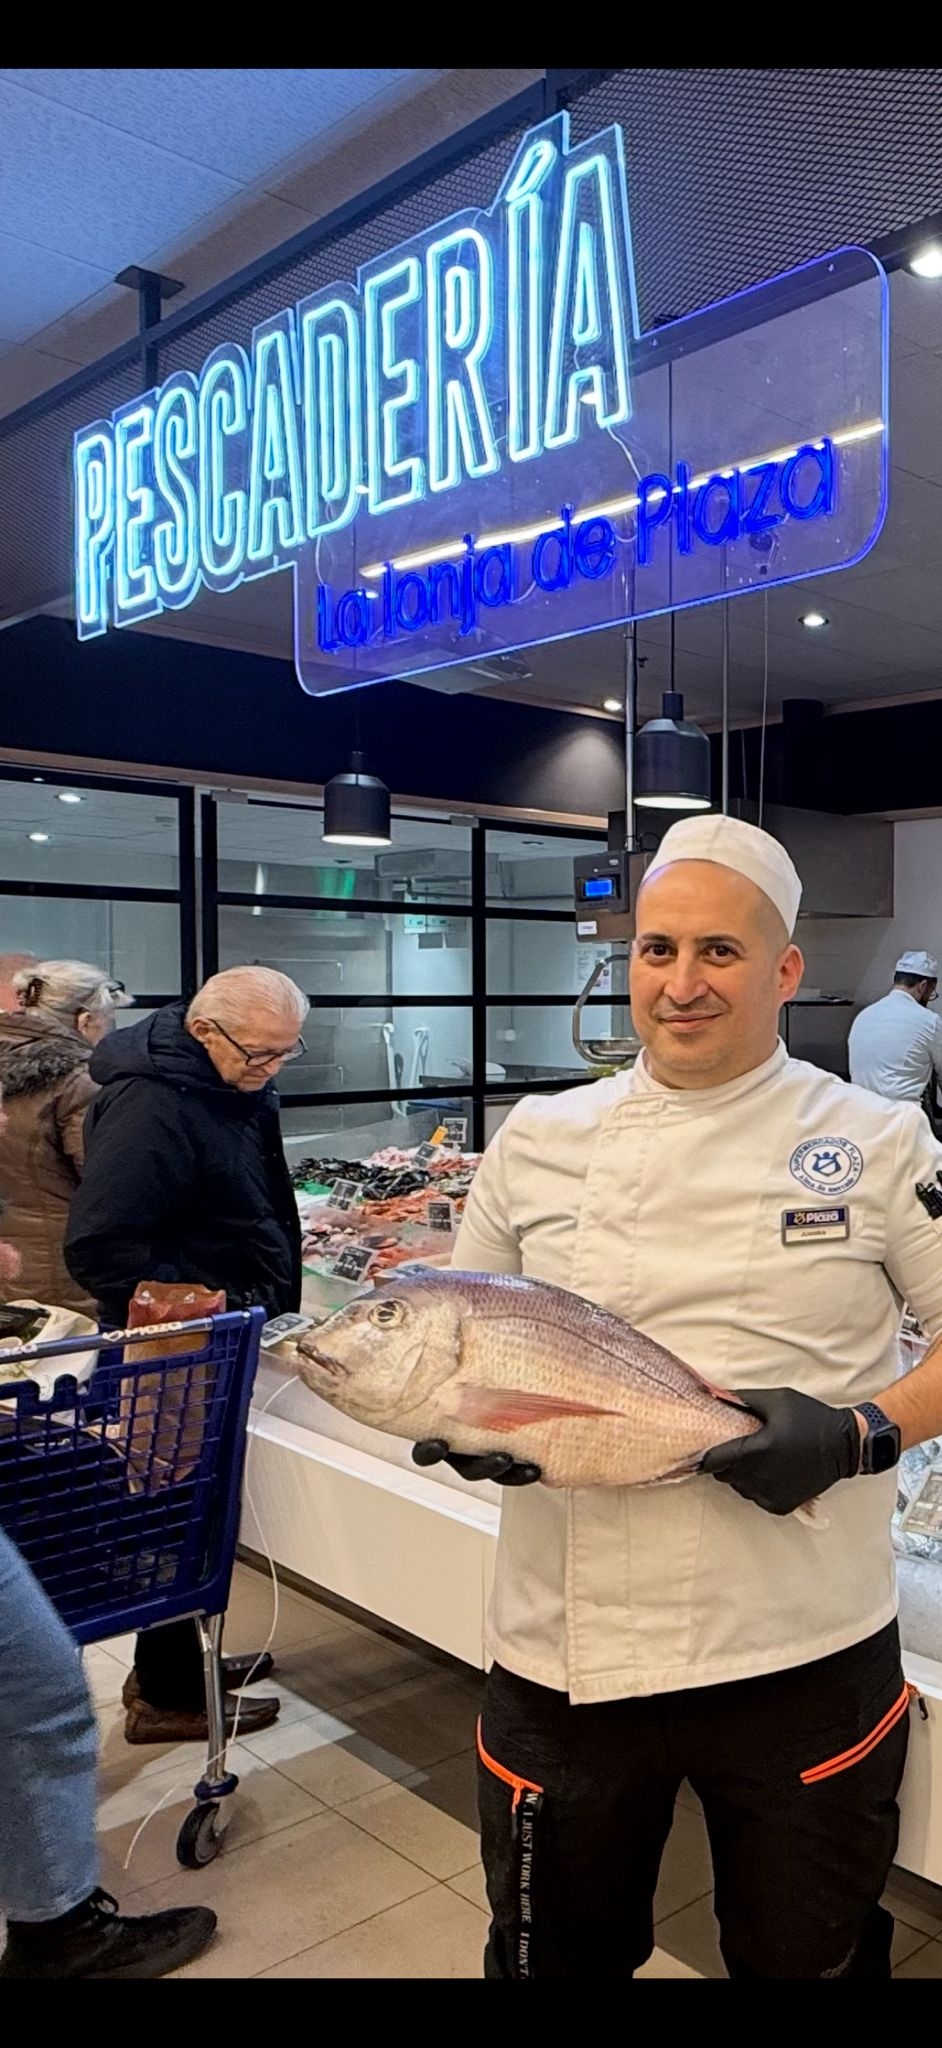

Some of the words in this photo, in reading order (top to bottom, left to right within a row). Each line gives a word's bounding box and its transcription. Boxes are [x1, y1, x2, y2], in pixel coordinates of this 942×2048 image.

[76, 138, 632, 624] PESCADERÍA
[383, 533, 514, 636] lonja
[533, 503, 616, 591] de
[637, 436, 834, 567] Plaza
[793, 1138, 848, 1172] SUPERMERCADOS
[848, 1147, 860, 1172] PLAZA
[806, 1211, 839, 1224] Plaza
[0, 1344, 38, 1358] aza
[521, 1818, 534, 1850] JUST
[519, 1853, 533, 1890] WORK
[520, 1892, 532, 1923] HERE
